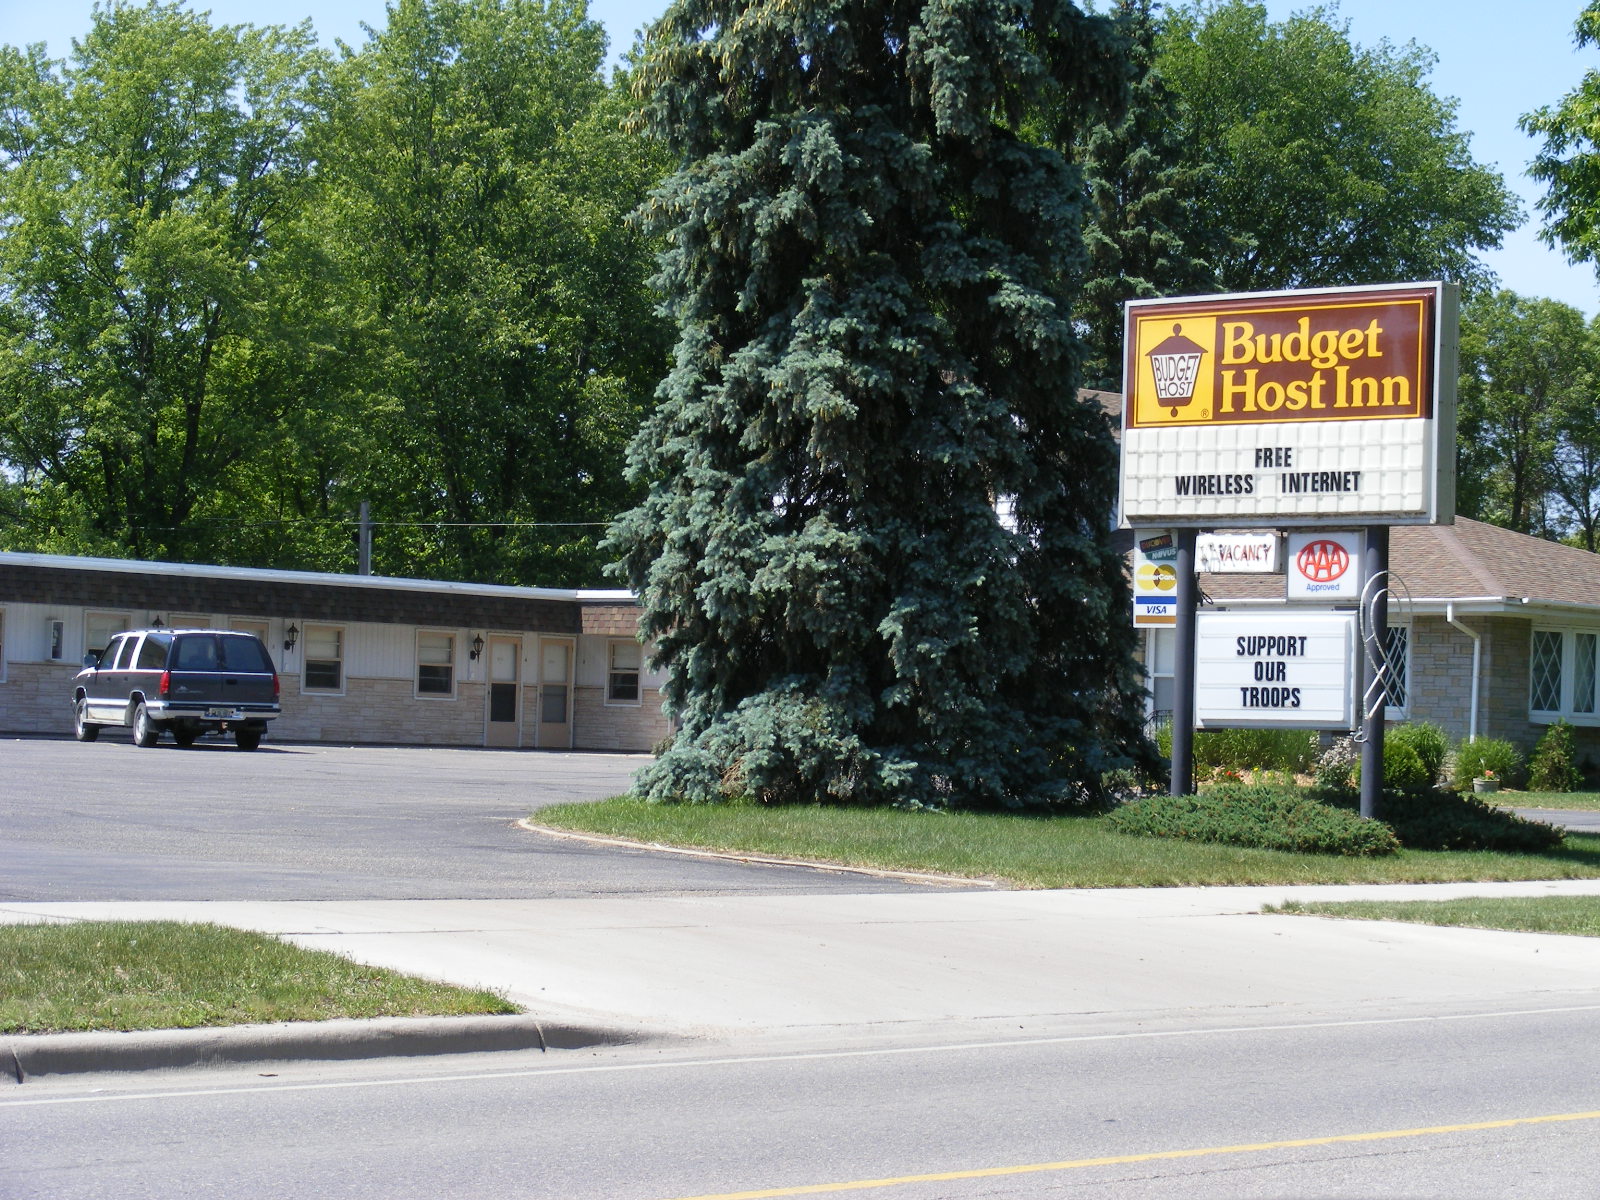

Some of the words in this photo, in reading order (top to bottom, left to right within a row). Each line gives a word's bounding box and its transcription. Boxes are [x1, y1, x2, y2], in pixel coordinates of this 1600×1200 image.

[1222, 316, 1383, 369] Budget
[1153, 355, 1199, 382] BUDGET
[1158, 382, 1192, 396] HOST
[1219, 369, 1326, 413] Host
[1333, 365, 1411, 408] Inn
[1255, 447, 1292, 468] FREE
[1175, 474, 1254, 495] WIRELESS
[1281, 470, 1361, 494] INTERNET
[1219, 544, 1272, 562] VACANCY
[1301, 542, 1346, 580] AAA
[1137, 573, 1176, 581] erCard
[1306, 583, 1340, 593] Approved
[1146, 605, 1167, 614] VISA
[1236, 636, 1307, 656] SUPPORT
[1254, 661, 1286, 682] OUR
[1240, 687, 1301, 708] TROOPS
